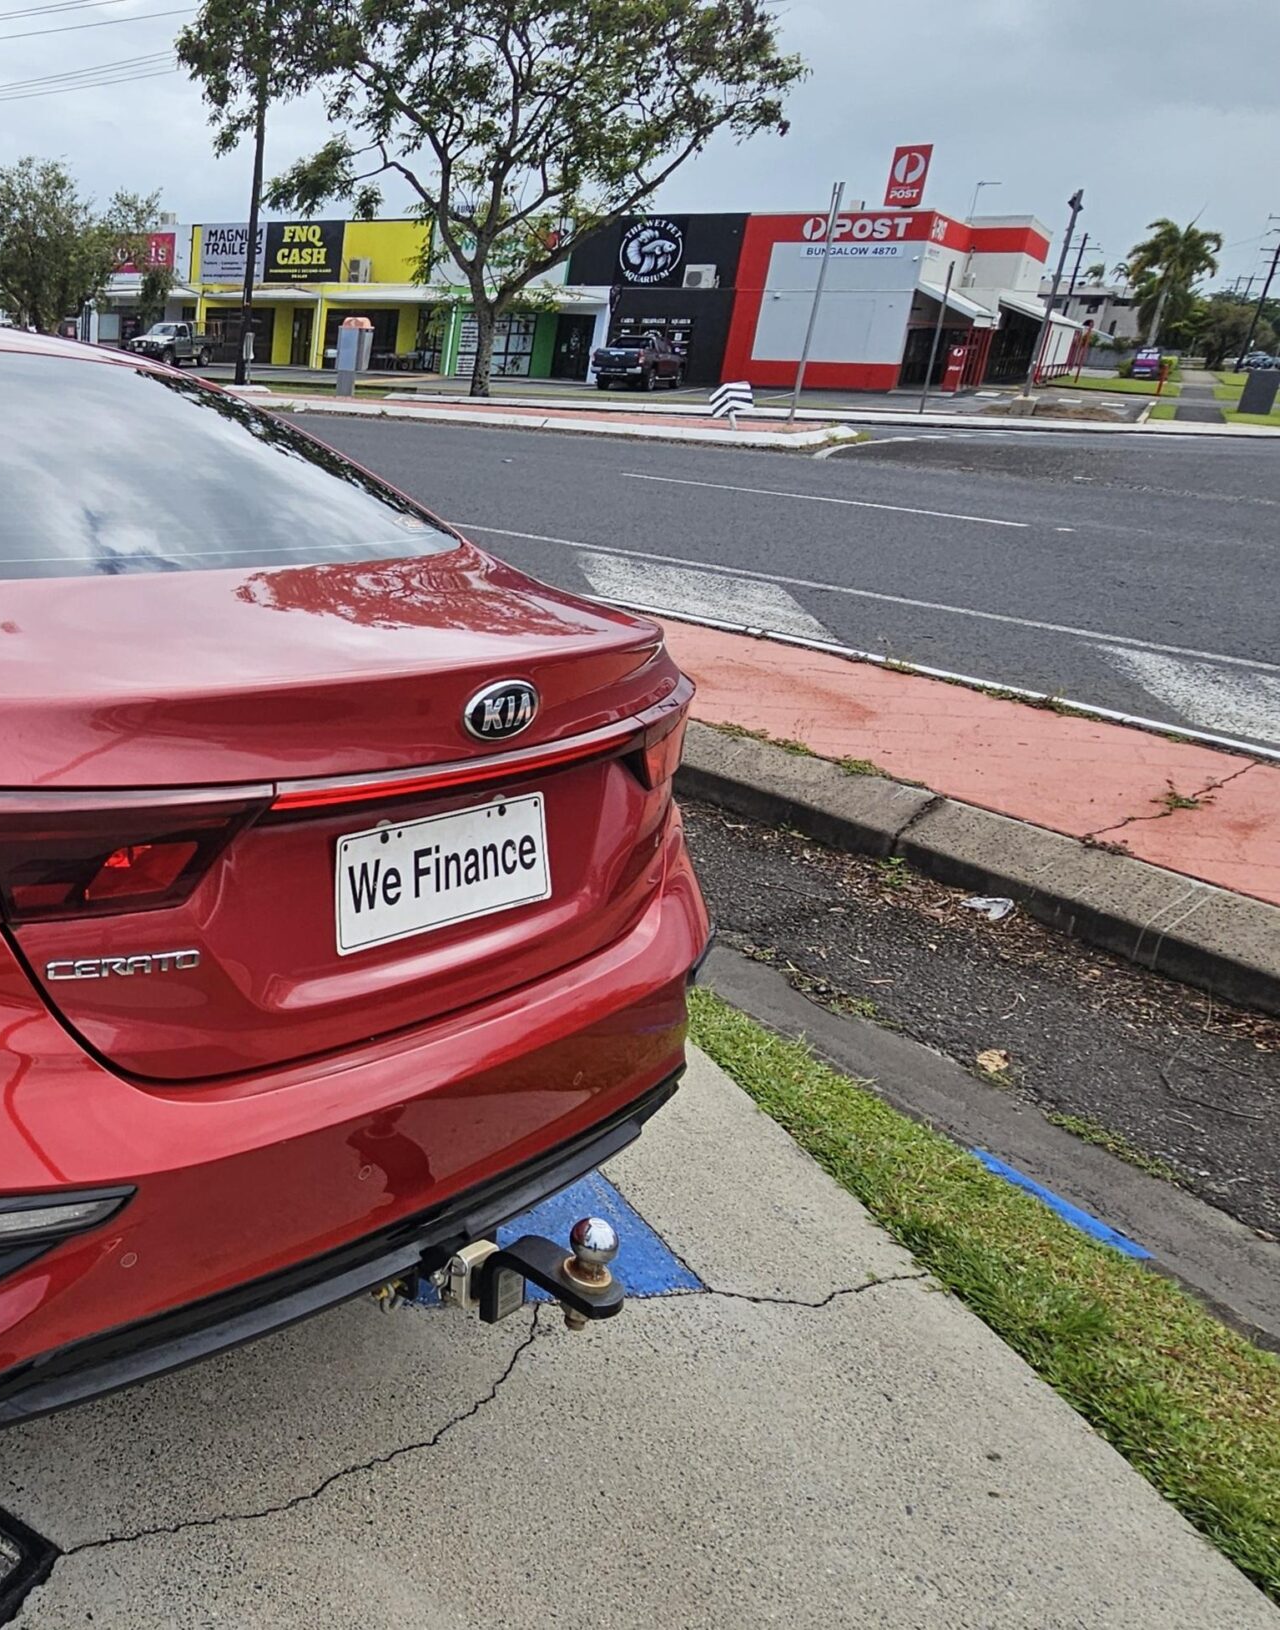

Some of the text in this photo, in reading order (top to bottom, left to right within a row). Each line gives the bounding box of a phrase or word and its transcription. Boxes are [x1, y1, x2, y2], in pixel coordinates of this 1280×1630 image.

[889, 189, 919, 199] POST
[282, 225, 323, 247] FNQ
[625, 219, 682, 238] THE WET PET
[832, 217, 913, 239] POST
[204, 242, 263, 255] TRAILES
[276, 247, 327, 265] CASH
[872, 247, 897, 255] 4870
[623, 269, 670, 283] AQUARIUM
[482, 692, 531, 731] KIA
[348, 834, 536, 914] We Finance
[47, 949, 200, 981] CERATO
